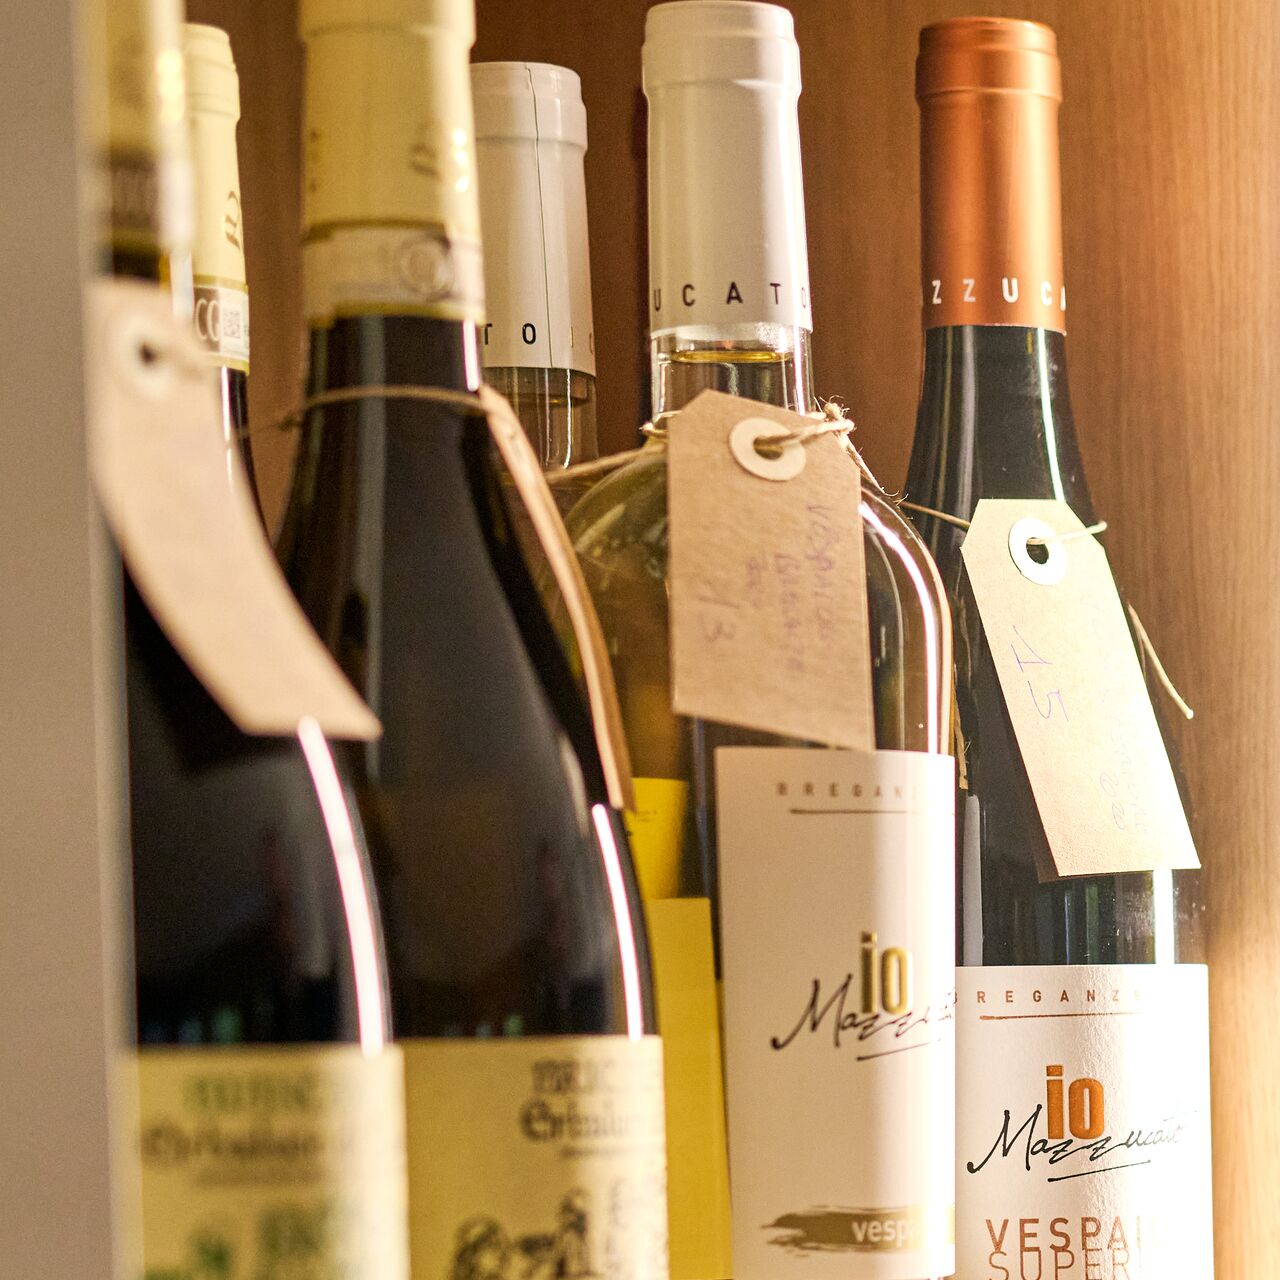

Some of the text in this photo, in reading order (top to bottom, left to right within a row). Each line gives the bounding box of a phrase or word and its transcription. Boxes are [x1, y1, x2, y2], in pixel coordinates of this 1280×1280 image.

[1010, 624, 1069, 723] 15
[860, 930, 910, 1016] io
[1046, 1064, 1106, 1140] io
